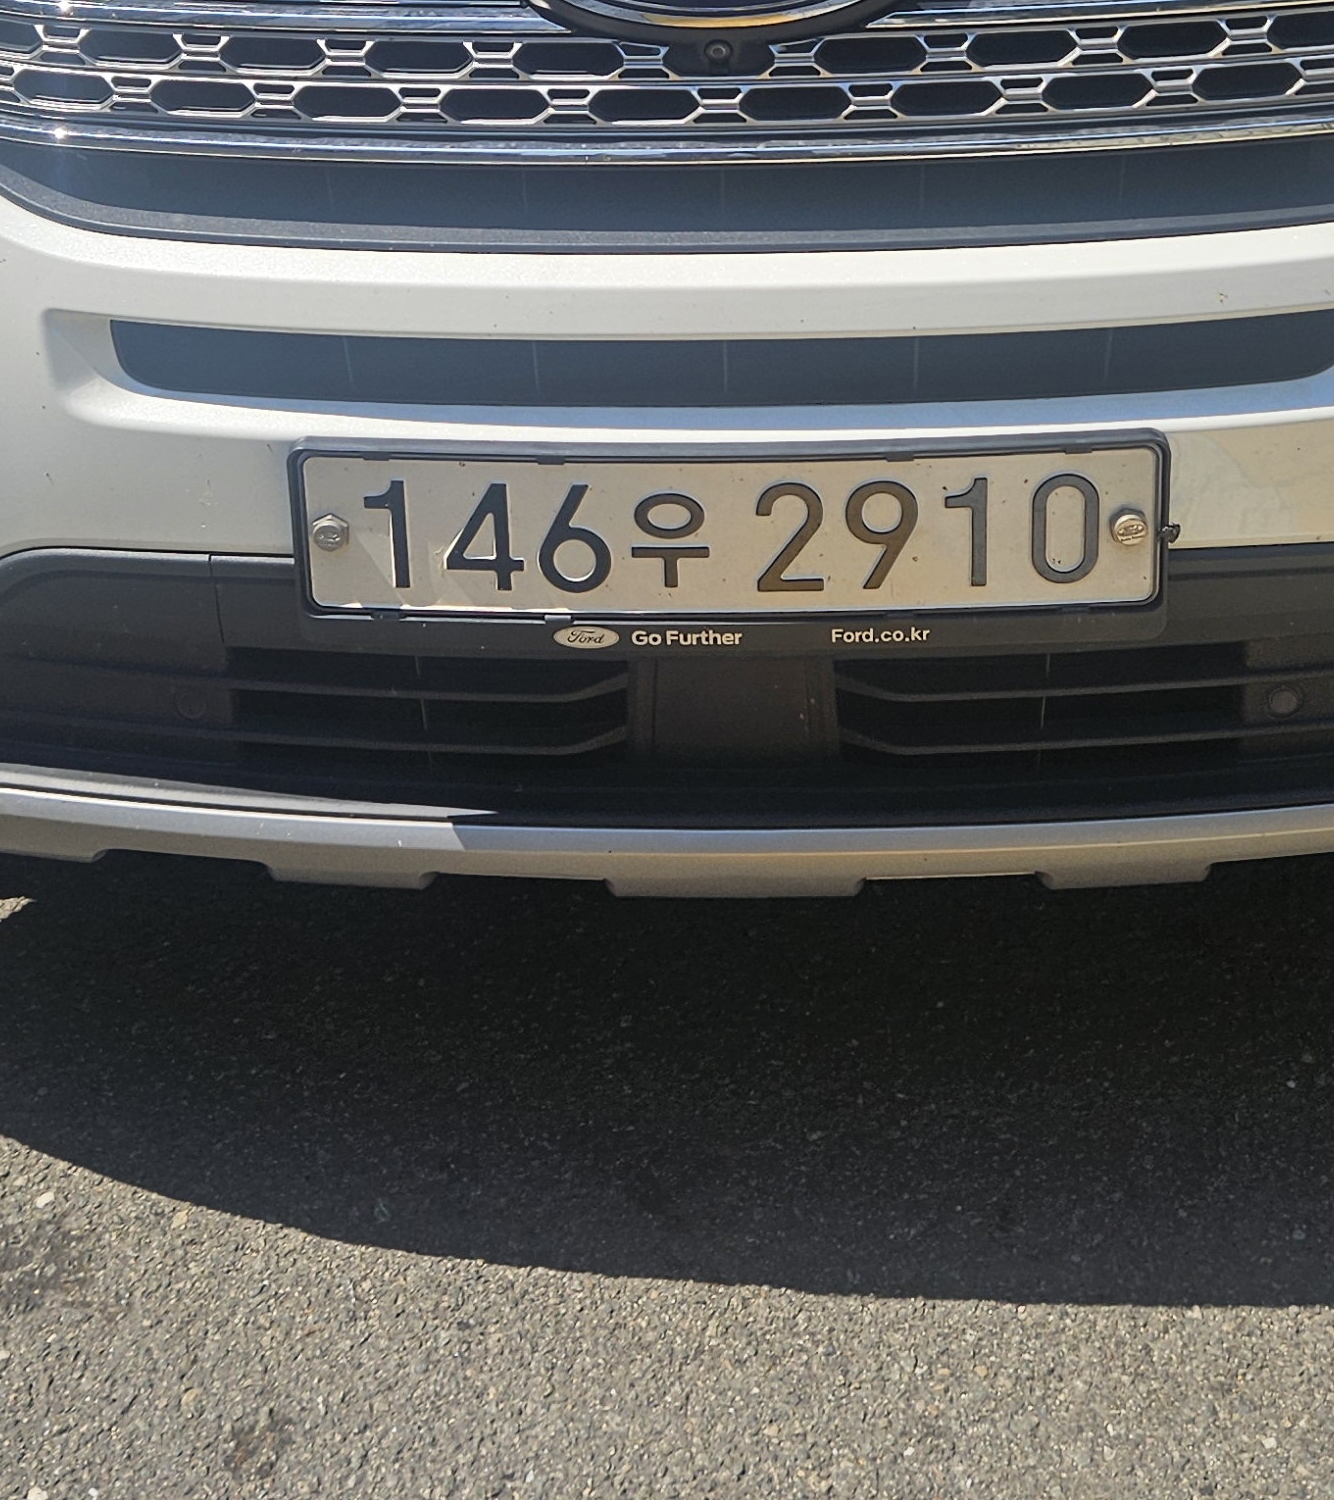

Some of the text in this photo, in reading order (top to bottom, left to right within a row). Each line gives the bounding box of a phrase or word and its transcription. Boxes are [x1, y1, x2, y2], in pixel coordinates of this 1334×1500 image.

[363, 472, 1100, 594] 146우 2910
[567, 629, 606, 644] Ford
[631, 629, 743, 645] Go Further
[831, 626, 931, 643] Ford.co.kr
